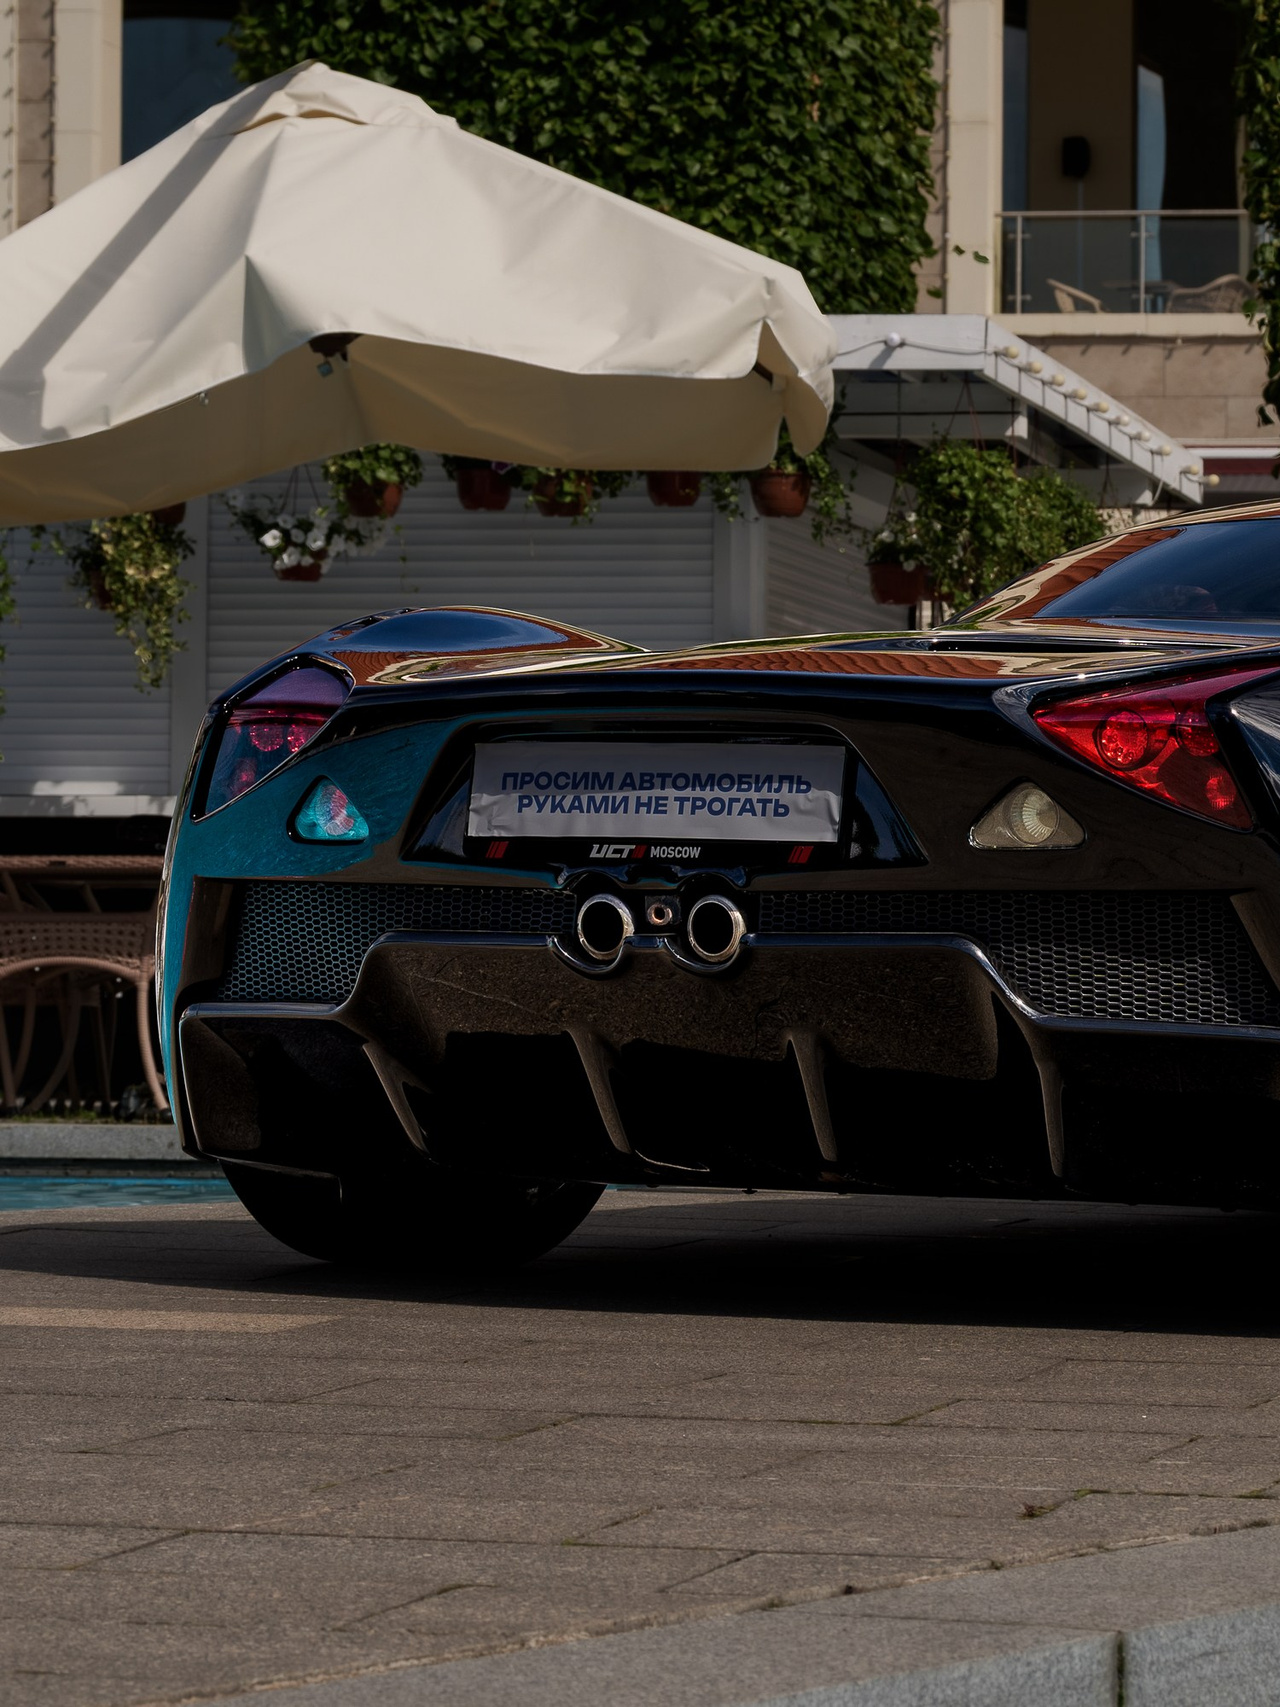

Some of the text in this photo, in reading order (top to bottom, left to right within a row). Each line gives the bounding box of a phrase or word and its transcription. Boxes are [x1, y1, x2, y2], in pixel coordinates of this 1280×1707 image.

[501, 771, 812, 794] ПРОСИМ АВТОМОБИЛЬ
[517, 794, 790, 818] РУКАМИ НЕ ТРОГАТЬ
[649, 845, 701, 859] MOSCOW
